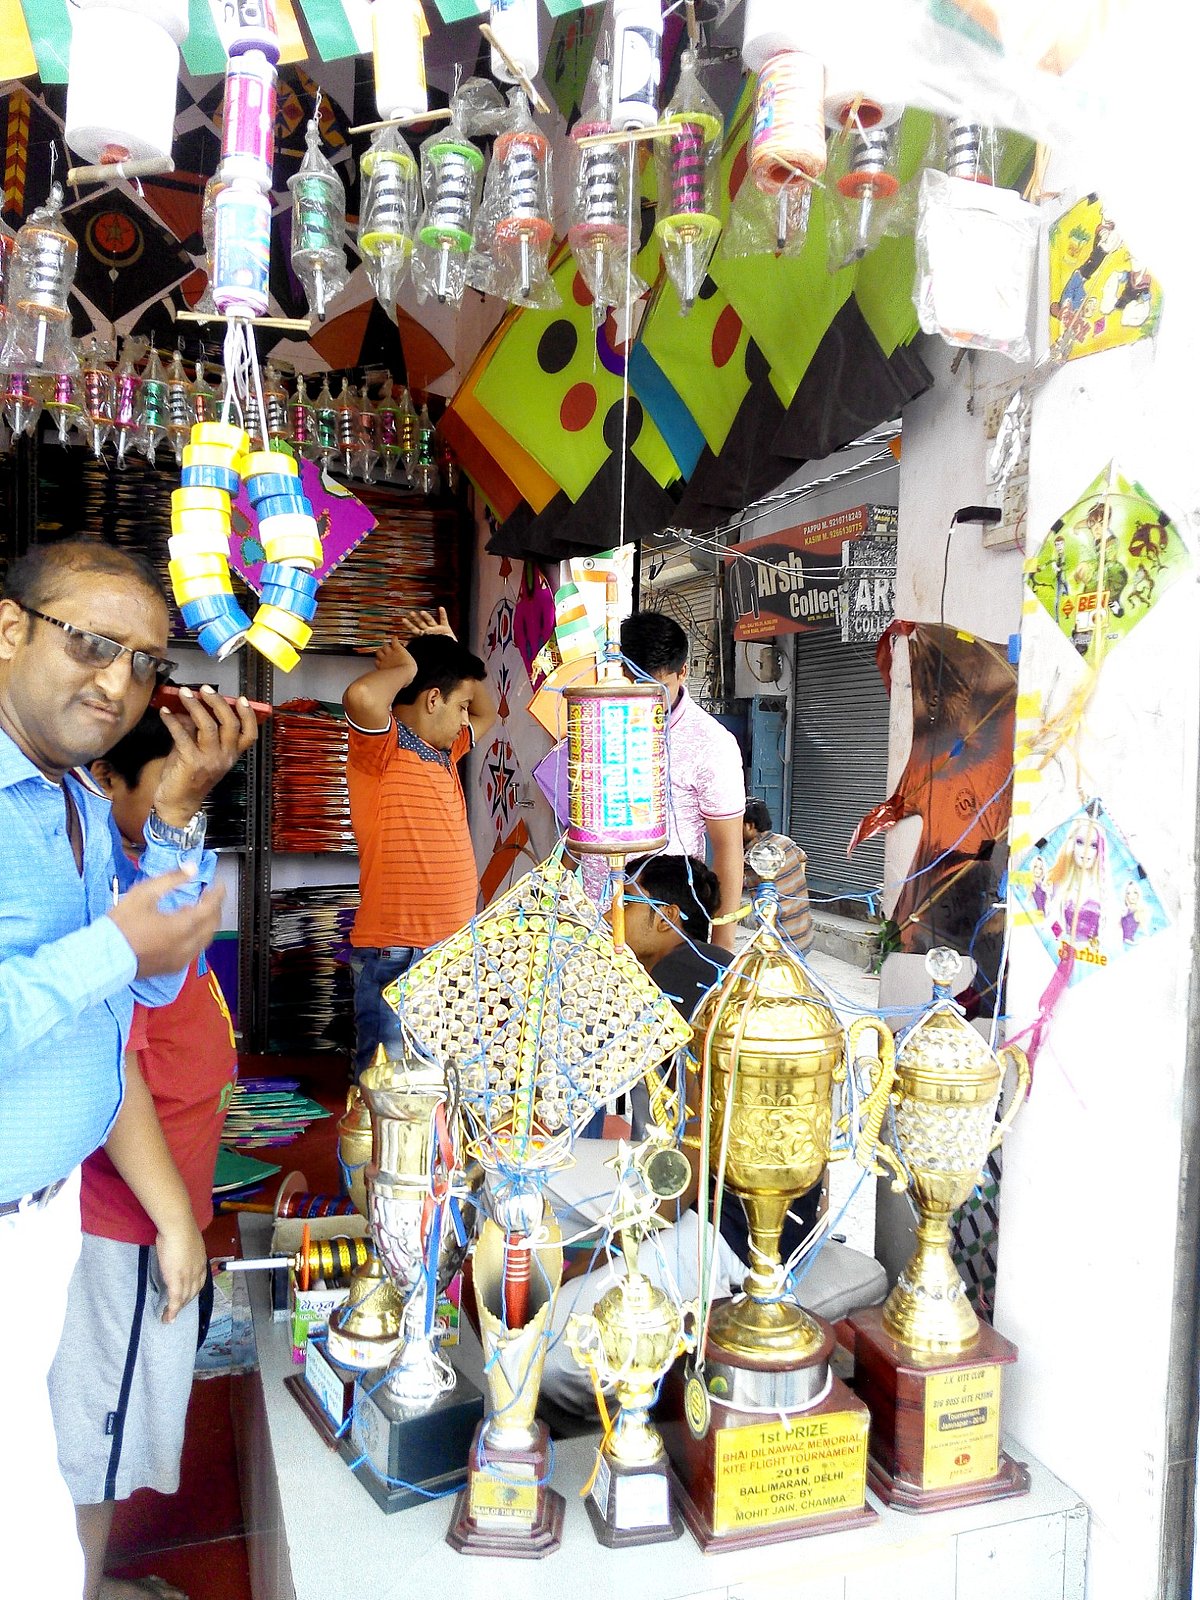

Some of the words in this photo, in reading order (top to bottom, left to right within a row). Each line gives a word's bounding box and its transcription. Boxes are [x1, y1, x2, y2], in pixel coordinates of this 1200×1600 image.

[803, 522, 822, 535] PAPPU
[804, 533, 822, 546] KASIM
[757, 551, 805, 598] Arsh
[760, 1431, 780, 1444] 1st
[785, 1422, 829, 1440] PRIZE
[722, 1450, 748, 1463] BHAI
[751, 1441, 804, 1459] DILNAWAZ
[807, 1433, 862, 1449] MEMORIAL
[723, 1462, 747, 1475] KITE
[750, 1457, 786, 1471] FLIGHT
[791, 1444, 862, 1464] TOURNAMENT
[740, 1477, 811, 1497] BALLIMARAN,
[814, 1471, 844, 1484] DELHI
[776, 1465, 810, 1479] 2016
[735, 1509, 769, 1521] MOHIT
[772, 1504, 798, 1516] JAIN,
[800, 1494, 846, 1510] CHAMMA
[770, 1491, 796, 1504] ORG.
[799, 1488, 813, 1498] BY
